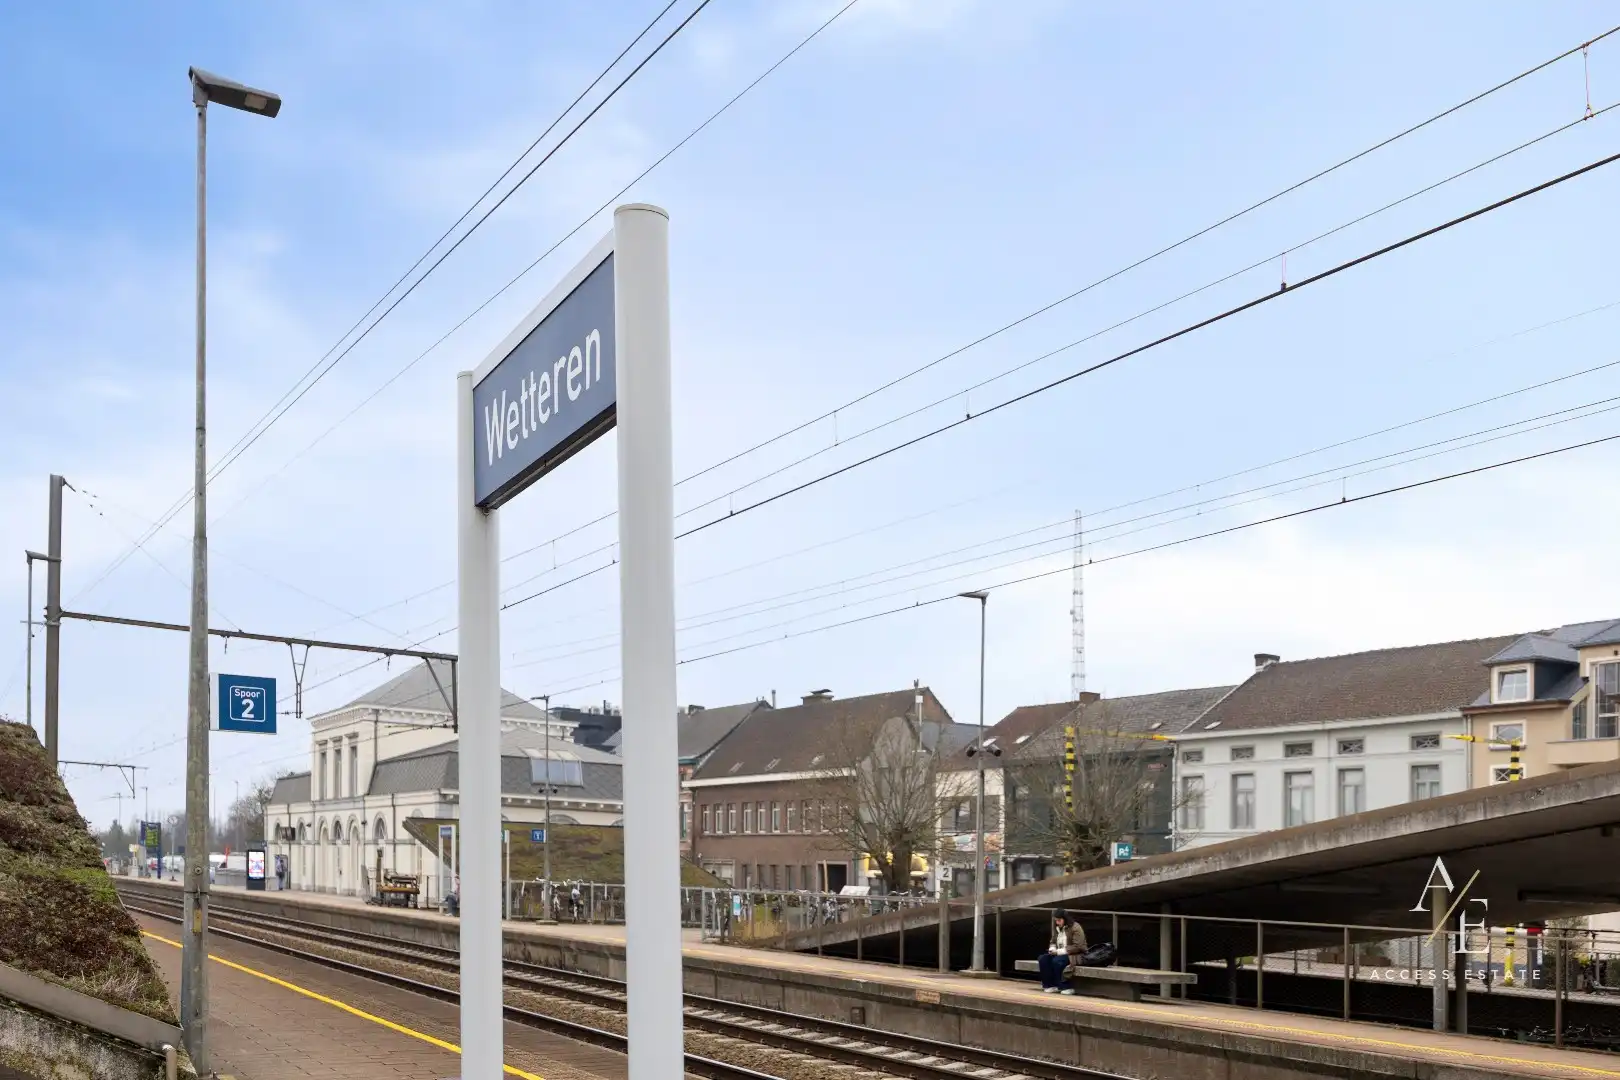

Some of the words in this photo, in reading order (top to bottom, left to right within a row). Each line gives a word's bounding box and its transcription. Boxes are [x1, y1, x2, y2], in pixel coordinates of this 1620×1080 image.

[484, 328, 601, 467] Wetteren
[234, 688, 261, 699] Spoor
[241, 698, 255, 719] 2
[942, 867, 950, 878] 2
